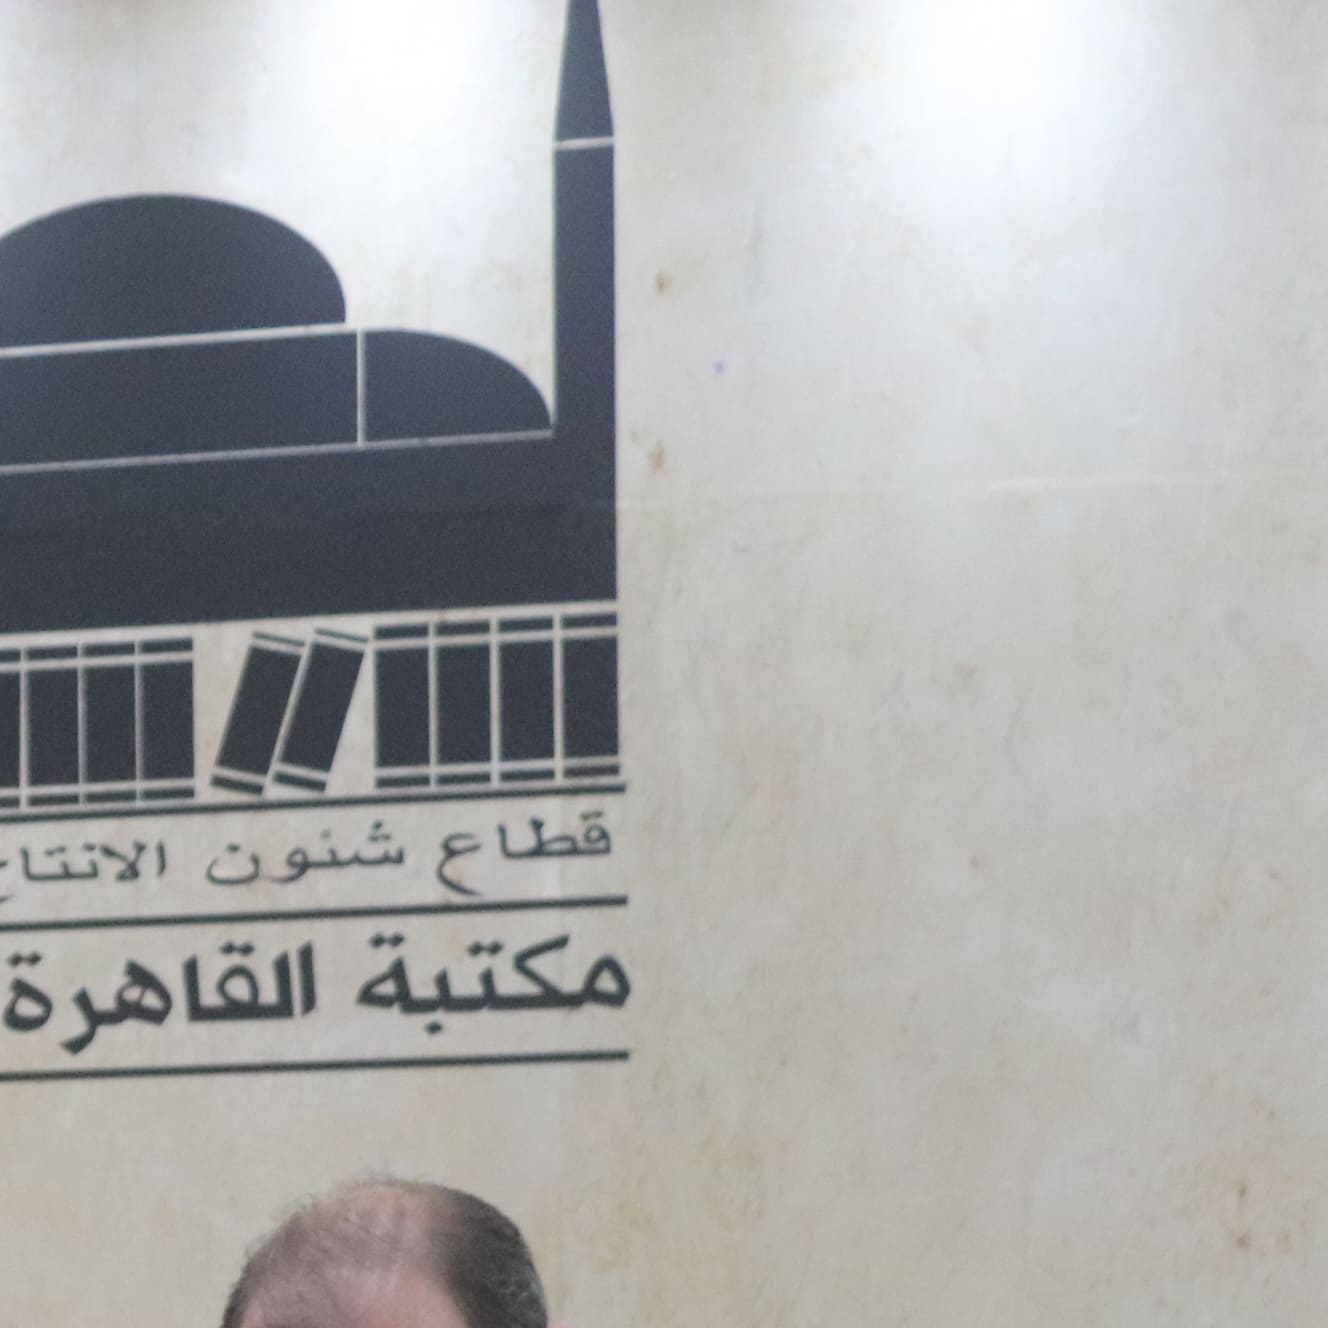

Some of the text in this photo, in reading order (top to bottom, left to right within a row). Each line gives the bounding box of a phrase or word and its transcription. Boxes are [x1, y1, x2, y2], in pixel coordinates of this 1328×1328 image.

[437, 811, 613, 897] قطاع
[1, 940, 318, 1057] القاهرة
[355, 932, 633, 1037] مكتبة
